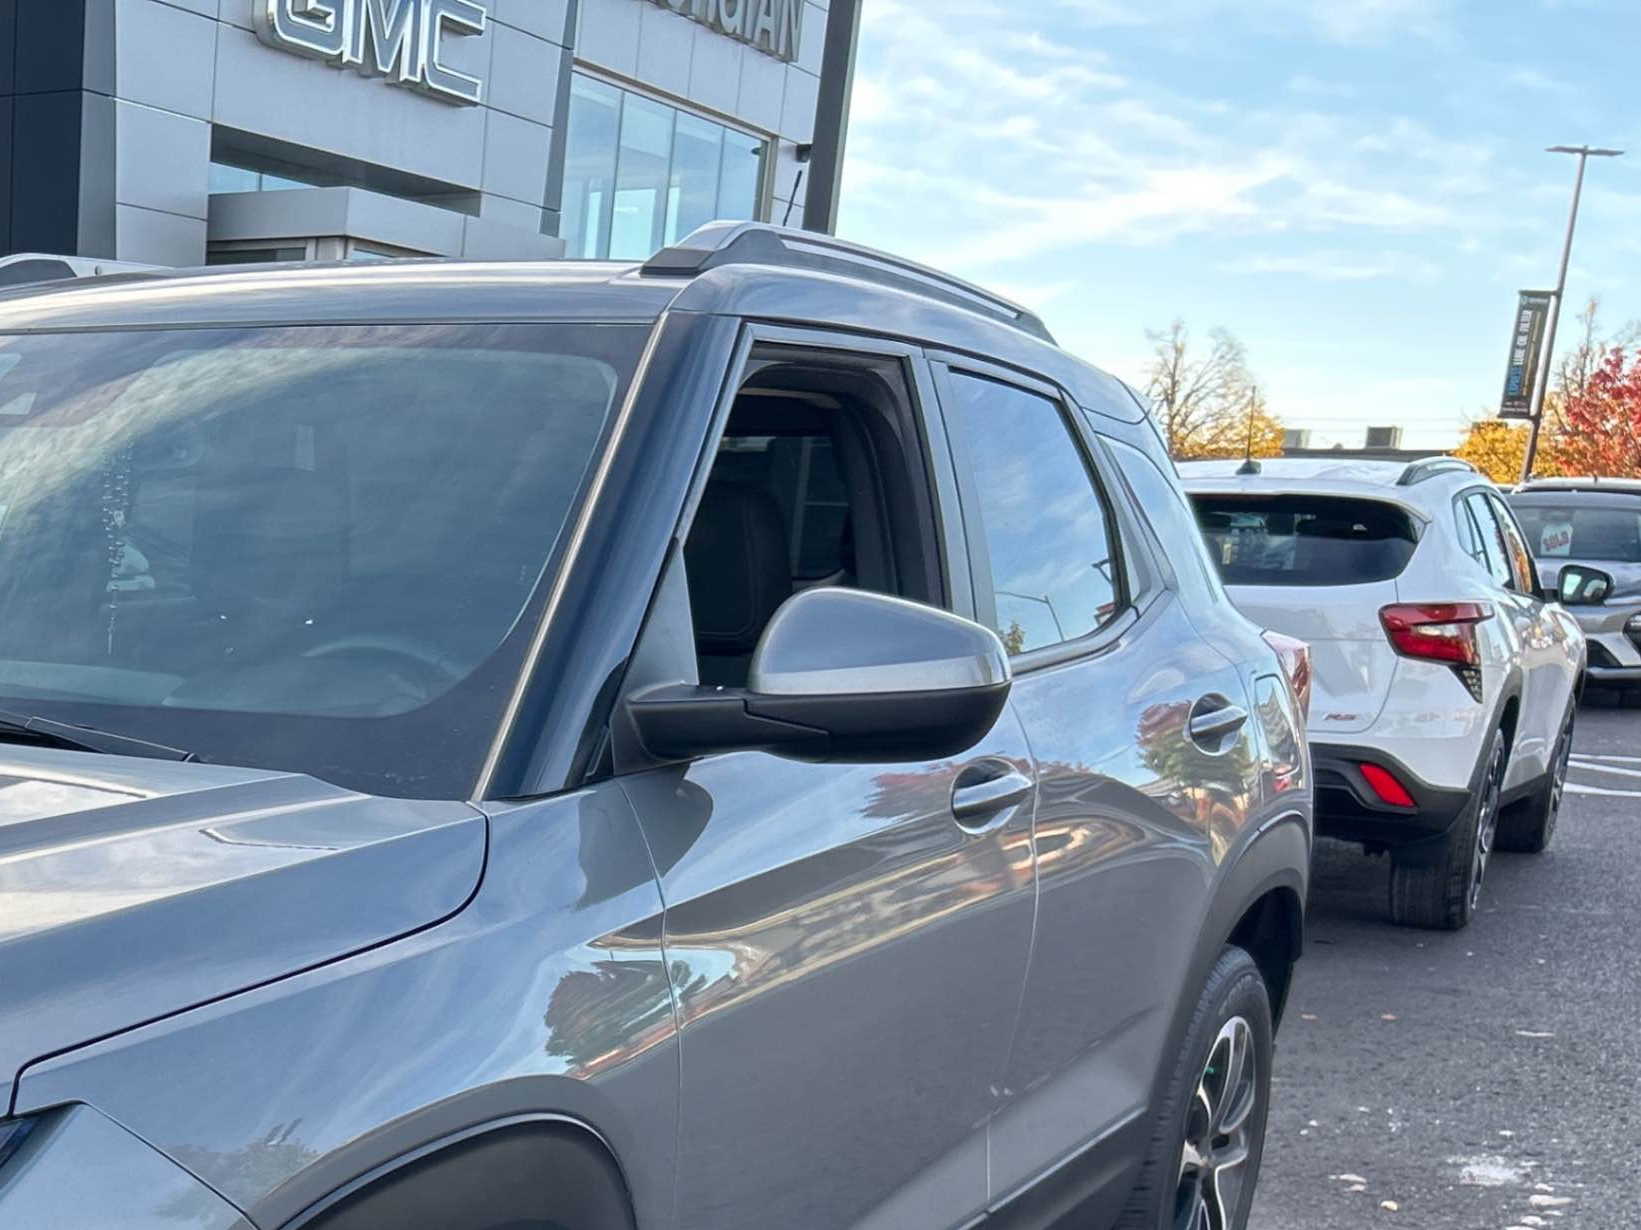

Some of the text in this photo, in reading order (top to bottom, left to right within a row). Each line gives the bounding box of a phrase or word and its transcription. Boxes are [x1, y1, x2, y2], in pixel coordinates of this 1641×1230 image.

[254, 0, 486, 107] GMC
[661, 0, 804, 63] GIAN
[1543, 531, 1569, 552] SOLD
